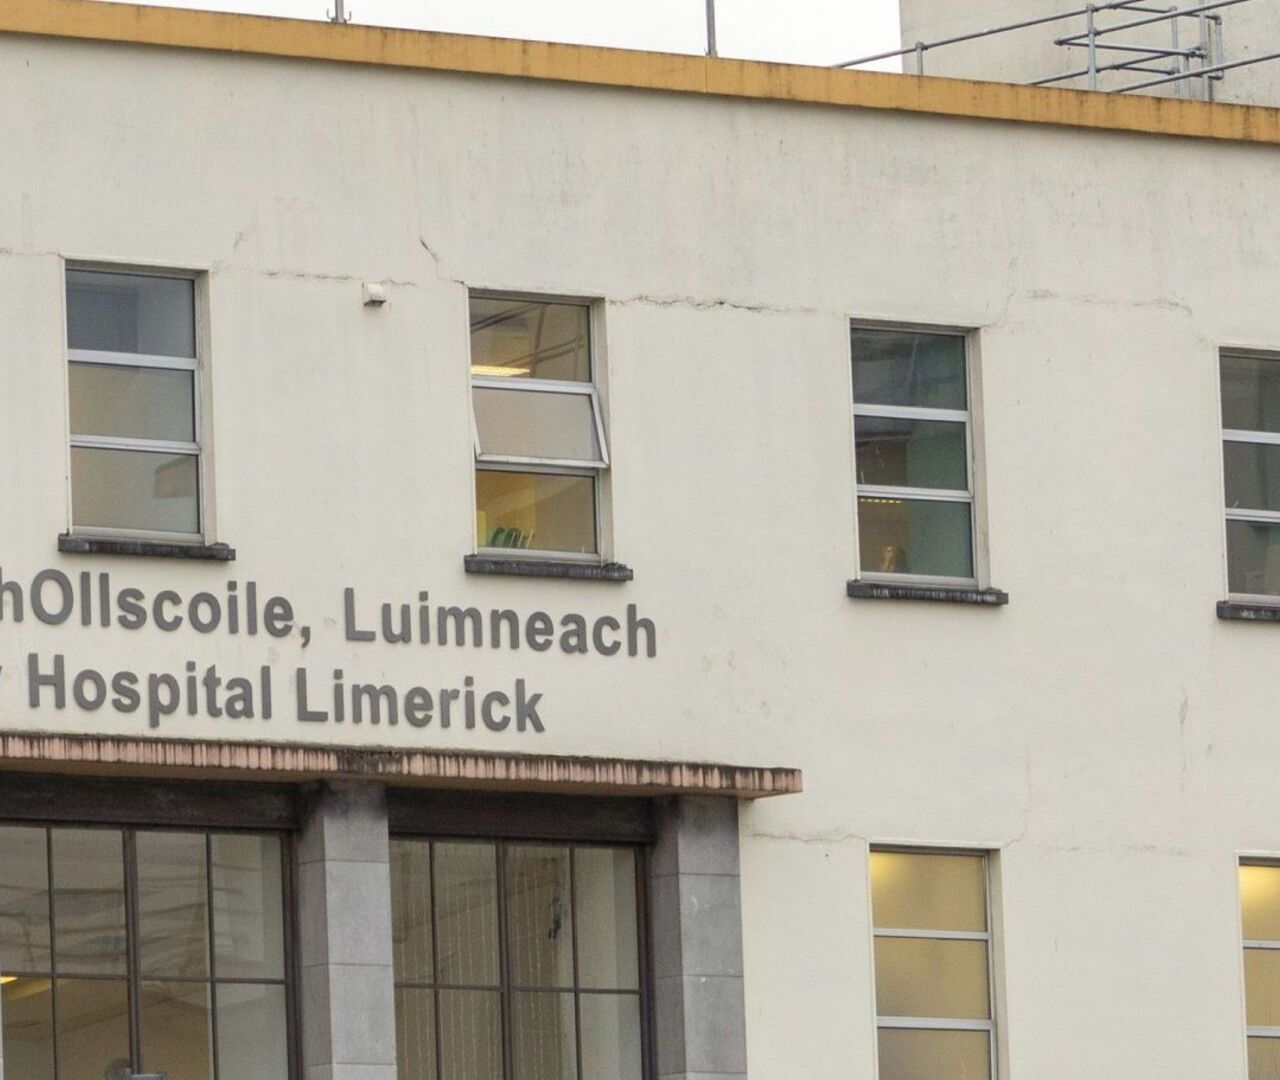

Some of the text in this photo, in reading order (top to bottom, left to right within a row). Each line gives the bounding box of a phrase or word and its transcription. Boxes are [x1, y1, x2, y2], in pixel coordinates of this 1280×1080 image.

[344, 587, 657, 658] Luimneach
[27, 652, 272, 728] Hospital
[296, 667, 545, 733] Limerick
